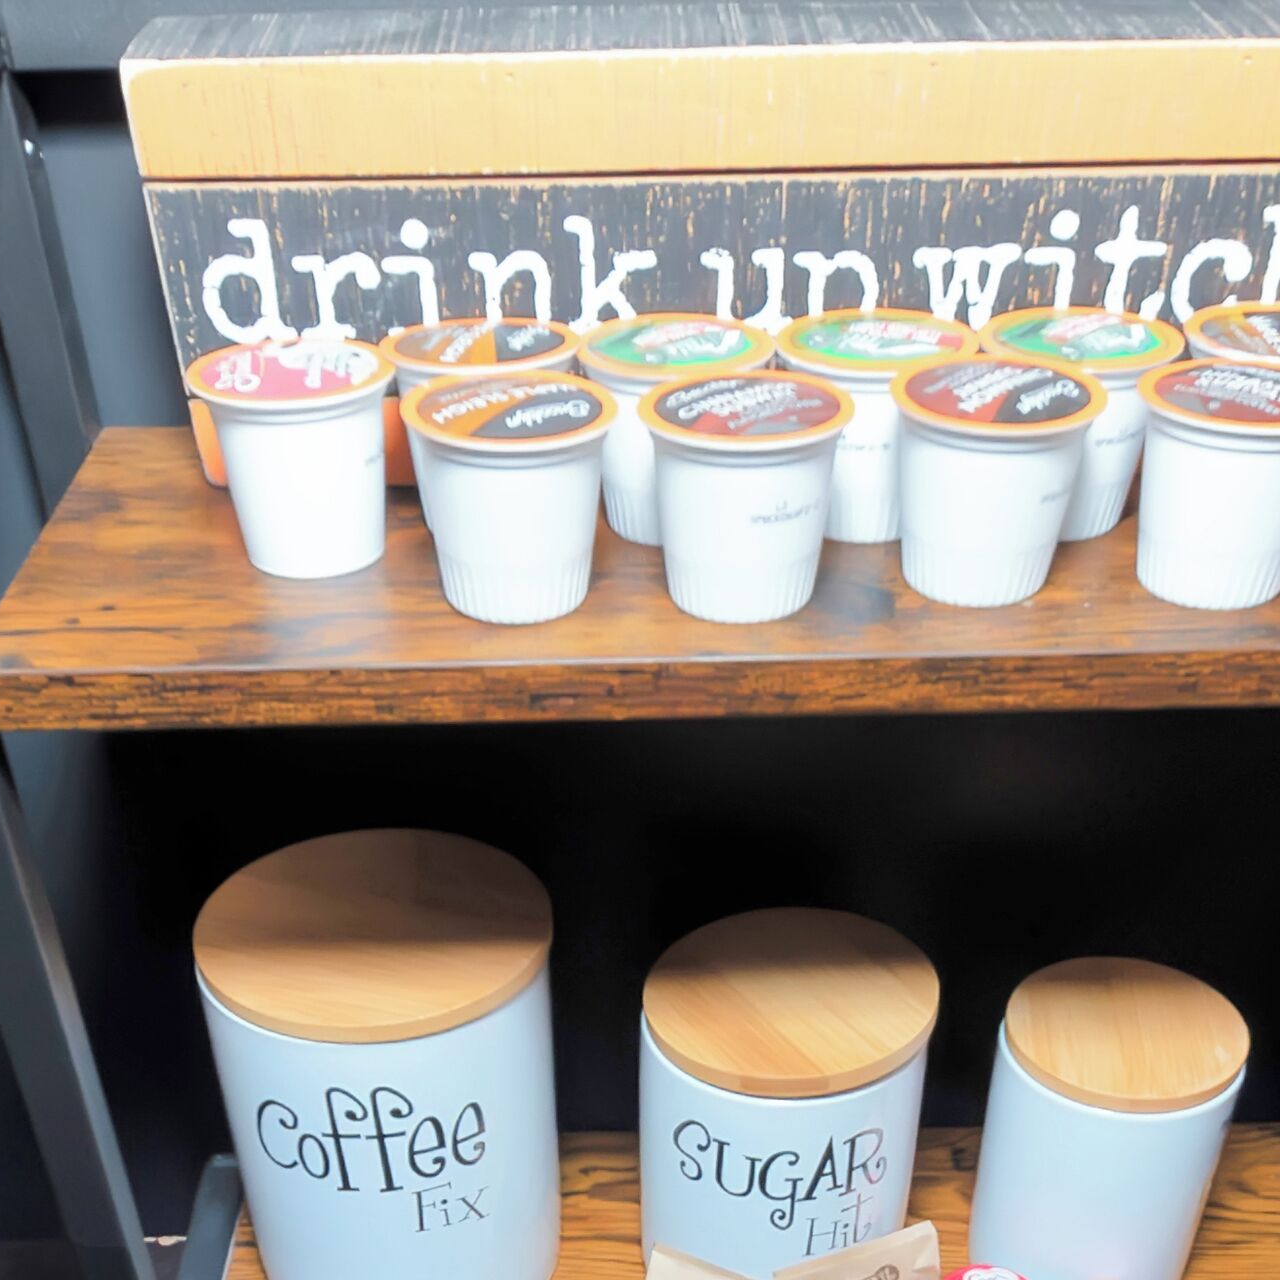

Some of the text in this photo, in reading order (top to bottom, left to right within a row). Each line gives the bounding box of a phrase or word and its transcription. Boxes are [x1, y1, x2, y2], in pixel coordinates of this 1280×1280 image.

[202, 215, 658, 346] drink
[257, 1086, 486, 1192] Coffee
[672, 1119, 887, 1230] SUGAR
[412, 1182, 490, 1232] Fix
[802, 1193, 875, 1257] Hit
